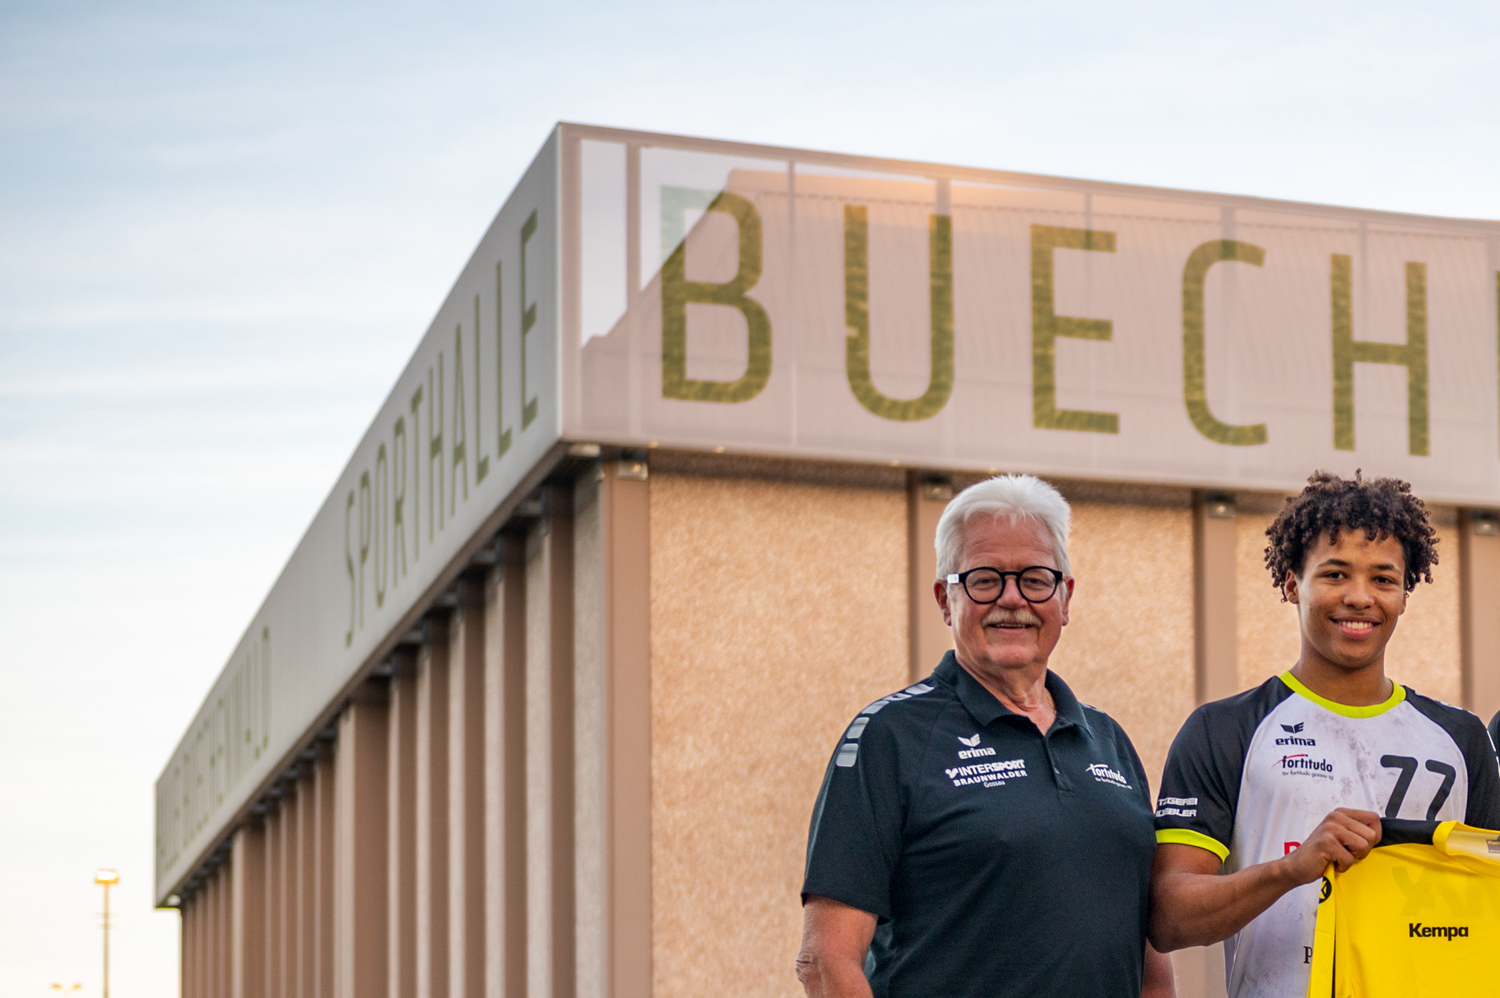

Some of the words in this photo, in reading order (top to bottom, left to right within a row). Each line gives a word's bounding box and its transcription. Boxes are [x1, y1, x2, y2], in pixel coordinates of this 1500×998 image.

[345, 206, 539, 650] SPORTHALLE
[1274, 735, 1316, 746] erima
[958, 746, 996, 760] erima
[957, 759, 1026, 777] INTERSPORT
[1281, 753, 1333, 773] fortitudo
[953, 769, 1028, 787] BRAUNWALDER
[1380, 754, 1456, 821] 77
[1409, 923, 1469, 941] Kempa
